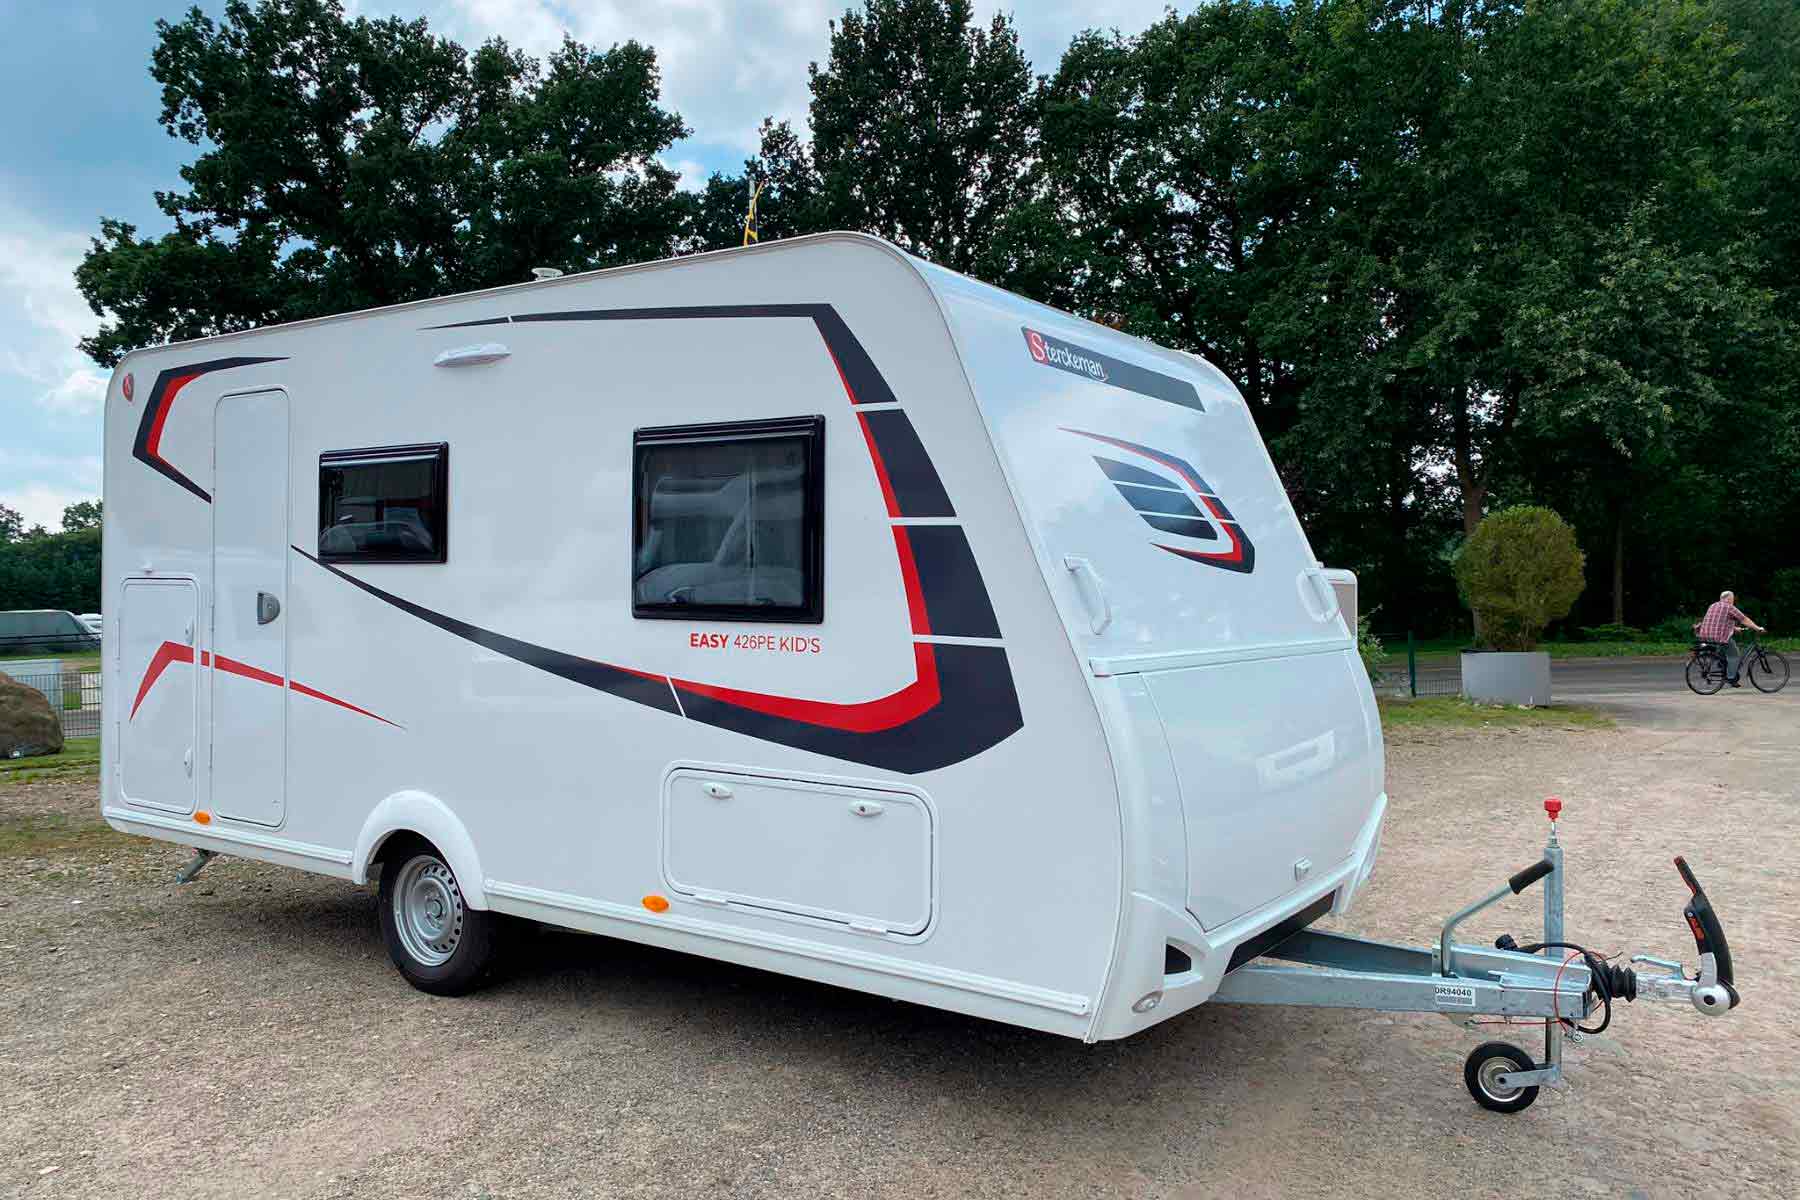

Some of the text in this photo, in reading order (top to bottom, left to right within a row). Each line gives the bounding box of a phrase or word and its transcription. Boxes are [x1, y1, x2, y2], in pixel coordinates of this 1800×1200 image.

[1030, 332, 1106, 379] Sterckeman
[690, 633, 821, 654] EASY 426PE KID'S
